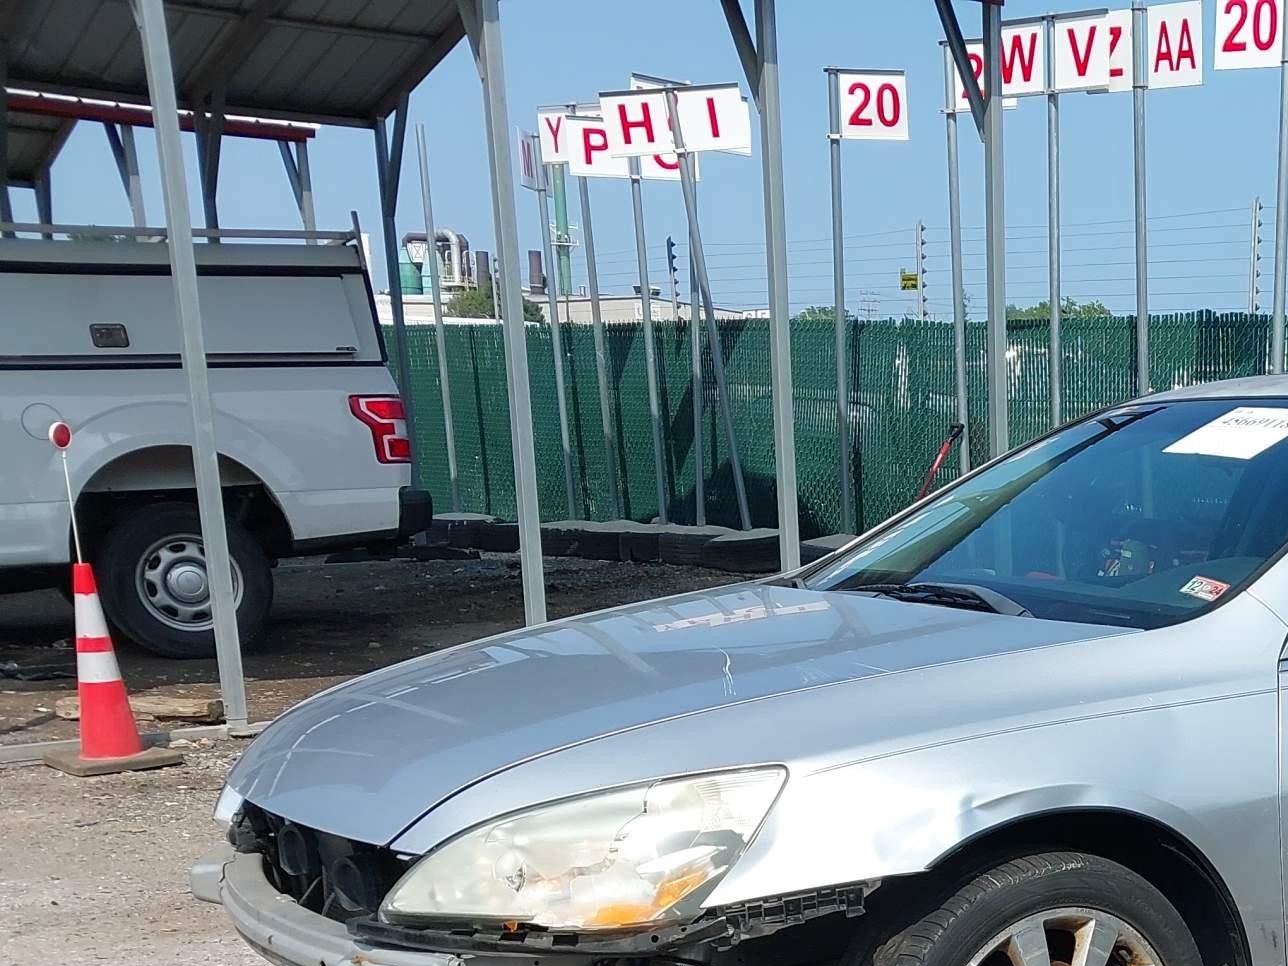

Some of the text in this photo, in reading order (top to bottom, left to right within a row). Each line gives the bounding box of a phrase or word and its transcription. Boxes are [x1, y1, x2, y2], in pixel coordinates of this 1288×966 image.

[1154, 19, 1197, 72] AA
[1222, 0, 1277, 51] 20
[1001, 33, 1038, 84] W
[1067, 26, 1097, 77] V
[617, 102, 655, 145] H
[706, 97, 720, 138] I
[847, 82, 901, 127] 20
[544, 116, 562, 153] Y
[582, 128, 609, 165] P
[521, 139, 533, 179] M
[1187, 580, 1204, 592] 12
